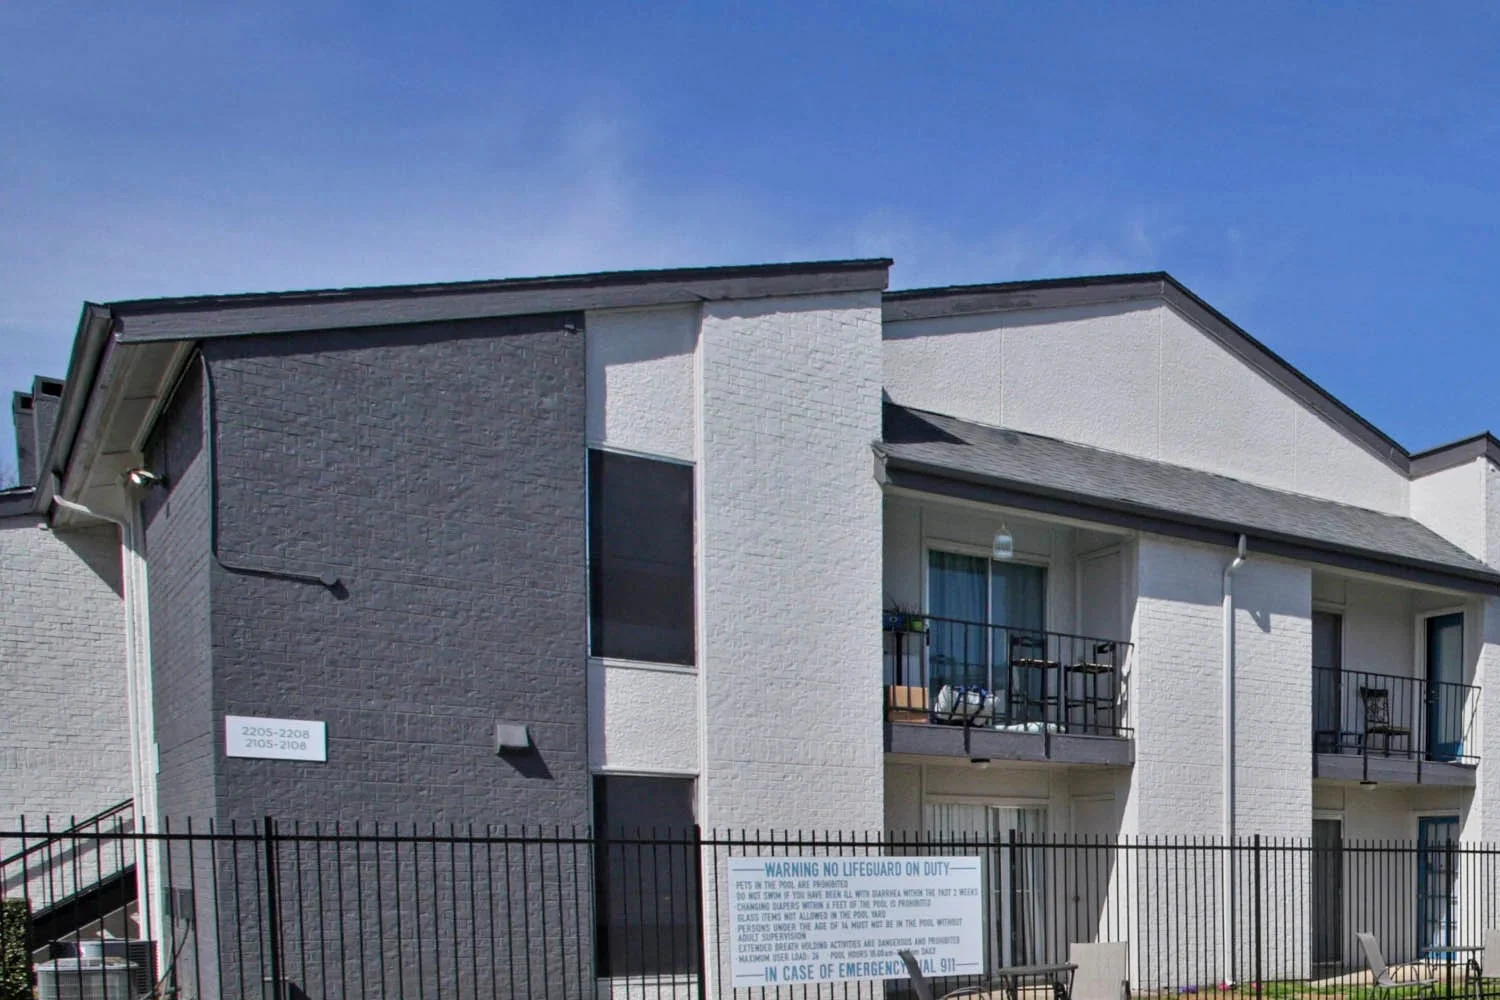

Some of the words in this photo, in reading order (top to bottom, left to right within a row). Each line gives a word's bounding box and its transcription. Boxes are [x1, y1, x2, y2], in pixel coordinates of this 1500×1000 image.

[241, 726, 311, 739] 2205-2208
[245, 738, 307, 750] 2105-2108
[765, 862, 819, 877] WARNING
[823, 862, 838, 876] NO
[843, 862, 901, 877] LIFEGUARD
[906, 861, 920, 876] ON
[924, 861, 950, 876] DUTY
[764, 881, 777, 889] THE
[779, 880, 794, 889] POOL
[798, 880, 810, 888] ARE
[813, 880, 848, 888] PROHIBITED
[749, 891, 761, 900] NOT
[764, 891, 781, 899] SWIM
[926, 888, 935, 896] THE
[959, 887, 979, 896] WEEKS
[773, 901, 800, 910] DIAPERS
[832, 900, 847, 909] FEET
[860, 899, 871, 908] THE
[873, 899, 888, 908] POOL
[784, 912, 797, 920] NOT
[799, 912, 829, 920] ALLOWED
[830, 911, 837, 919] IN
[839, 911, 851, 920] THE
[853, 910, 868, 919] POOL
[738, 923, 771, 932] PERSONS
[773, 923, 796, 931] UNDER
[800, 922, 811, 931] THE
[815, 922, 827, 930] AGE
[830, 921, 838, 930] OF
[871, 920, 883, 928] NOT
[886, 920, 894, 928] BE
[896, 920, 903, 928] IN
[905, 919, 917, 928] THE
[919, 919, 935, 928] POOL
[936, 918, 962, 927] WITHOUT
[761, 932, 807, 941] SUPERVISION
[864, 939, 875, 947] ARE
[878, 938, 912, 947] DANGEROUS
[928, 936, 960, 945] PROHIBITED
[772, 953, 789, 962] USER
[765, 967, 777, 981] IN
[783, 965, 814, 981] CASE
[820, 964, 833, 979] OF
[839, 960, 907, 978] EMERGENCY
[940, 958, 956, 973] 911
